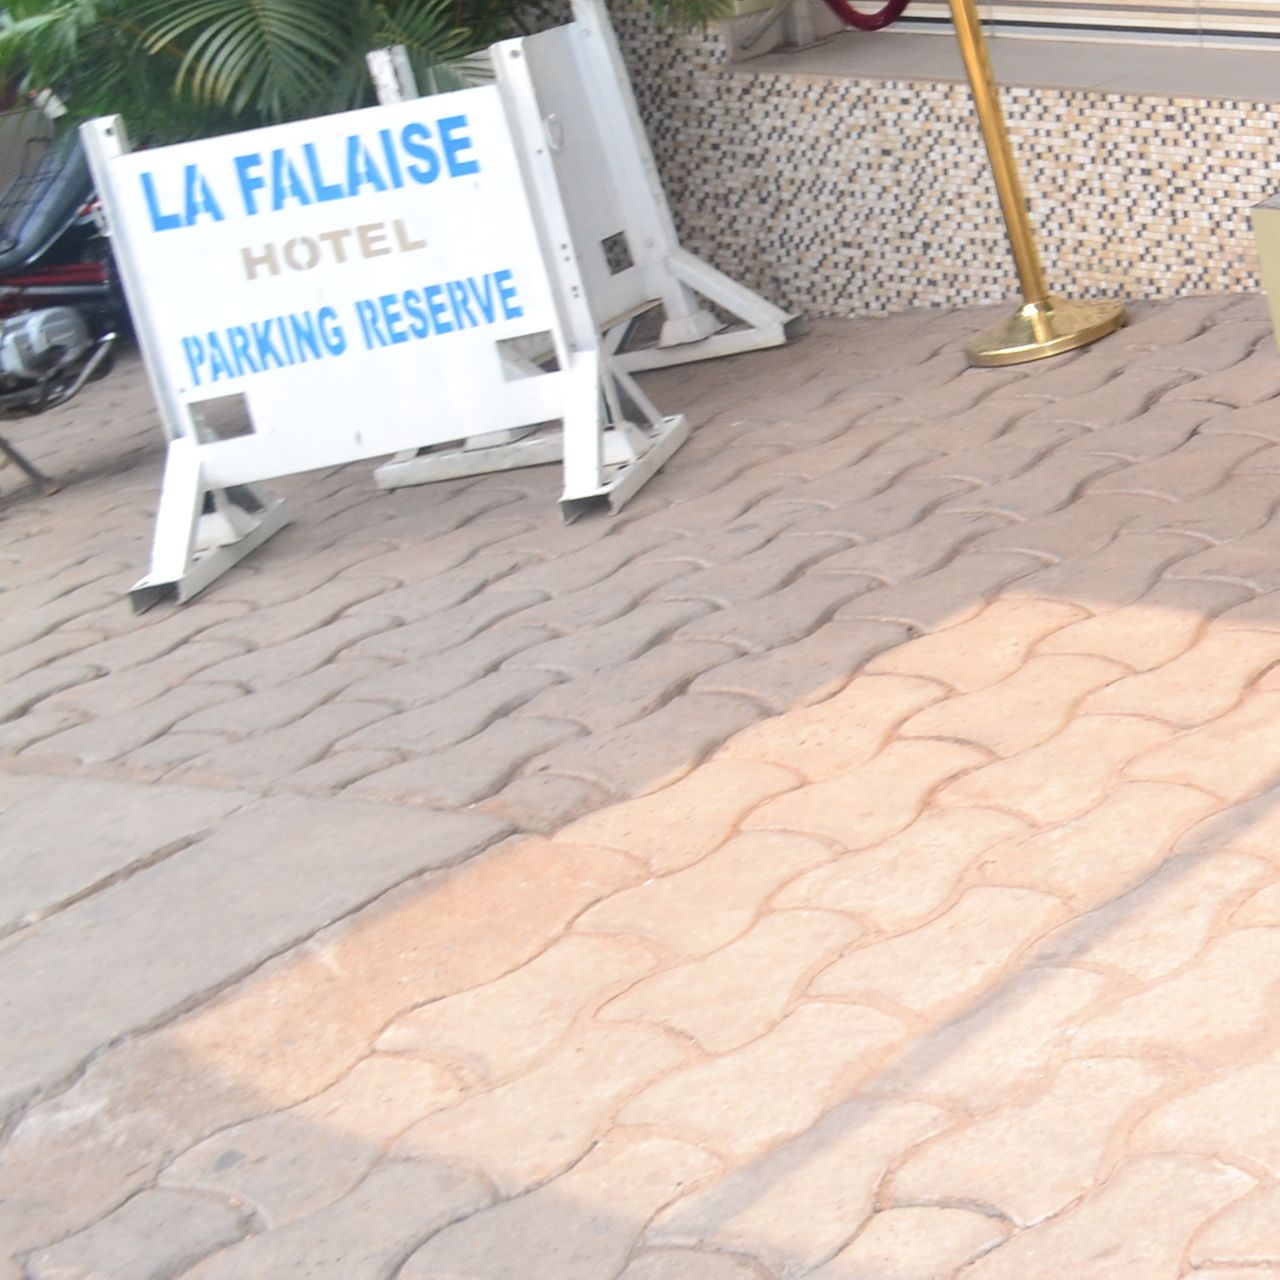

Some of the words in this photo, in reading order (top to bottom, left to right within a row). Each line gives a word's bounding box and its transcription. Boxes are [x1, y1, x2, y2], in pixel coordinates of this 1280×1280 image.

[138, 163, 225, 233] LA
[233, 114, 482, 217] FALAISE
[240, 218, 428, 281] HOTEL
[181, 305, 348, 387] PARKING
[354, 268, 525, 351] RESERVE
